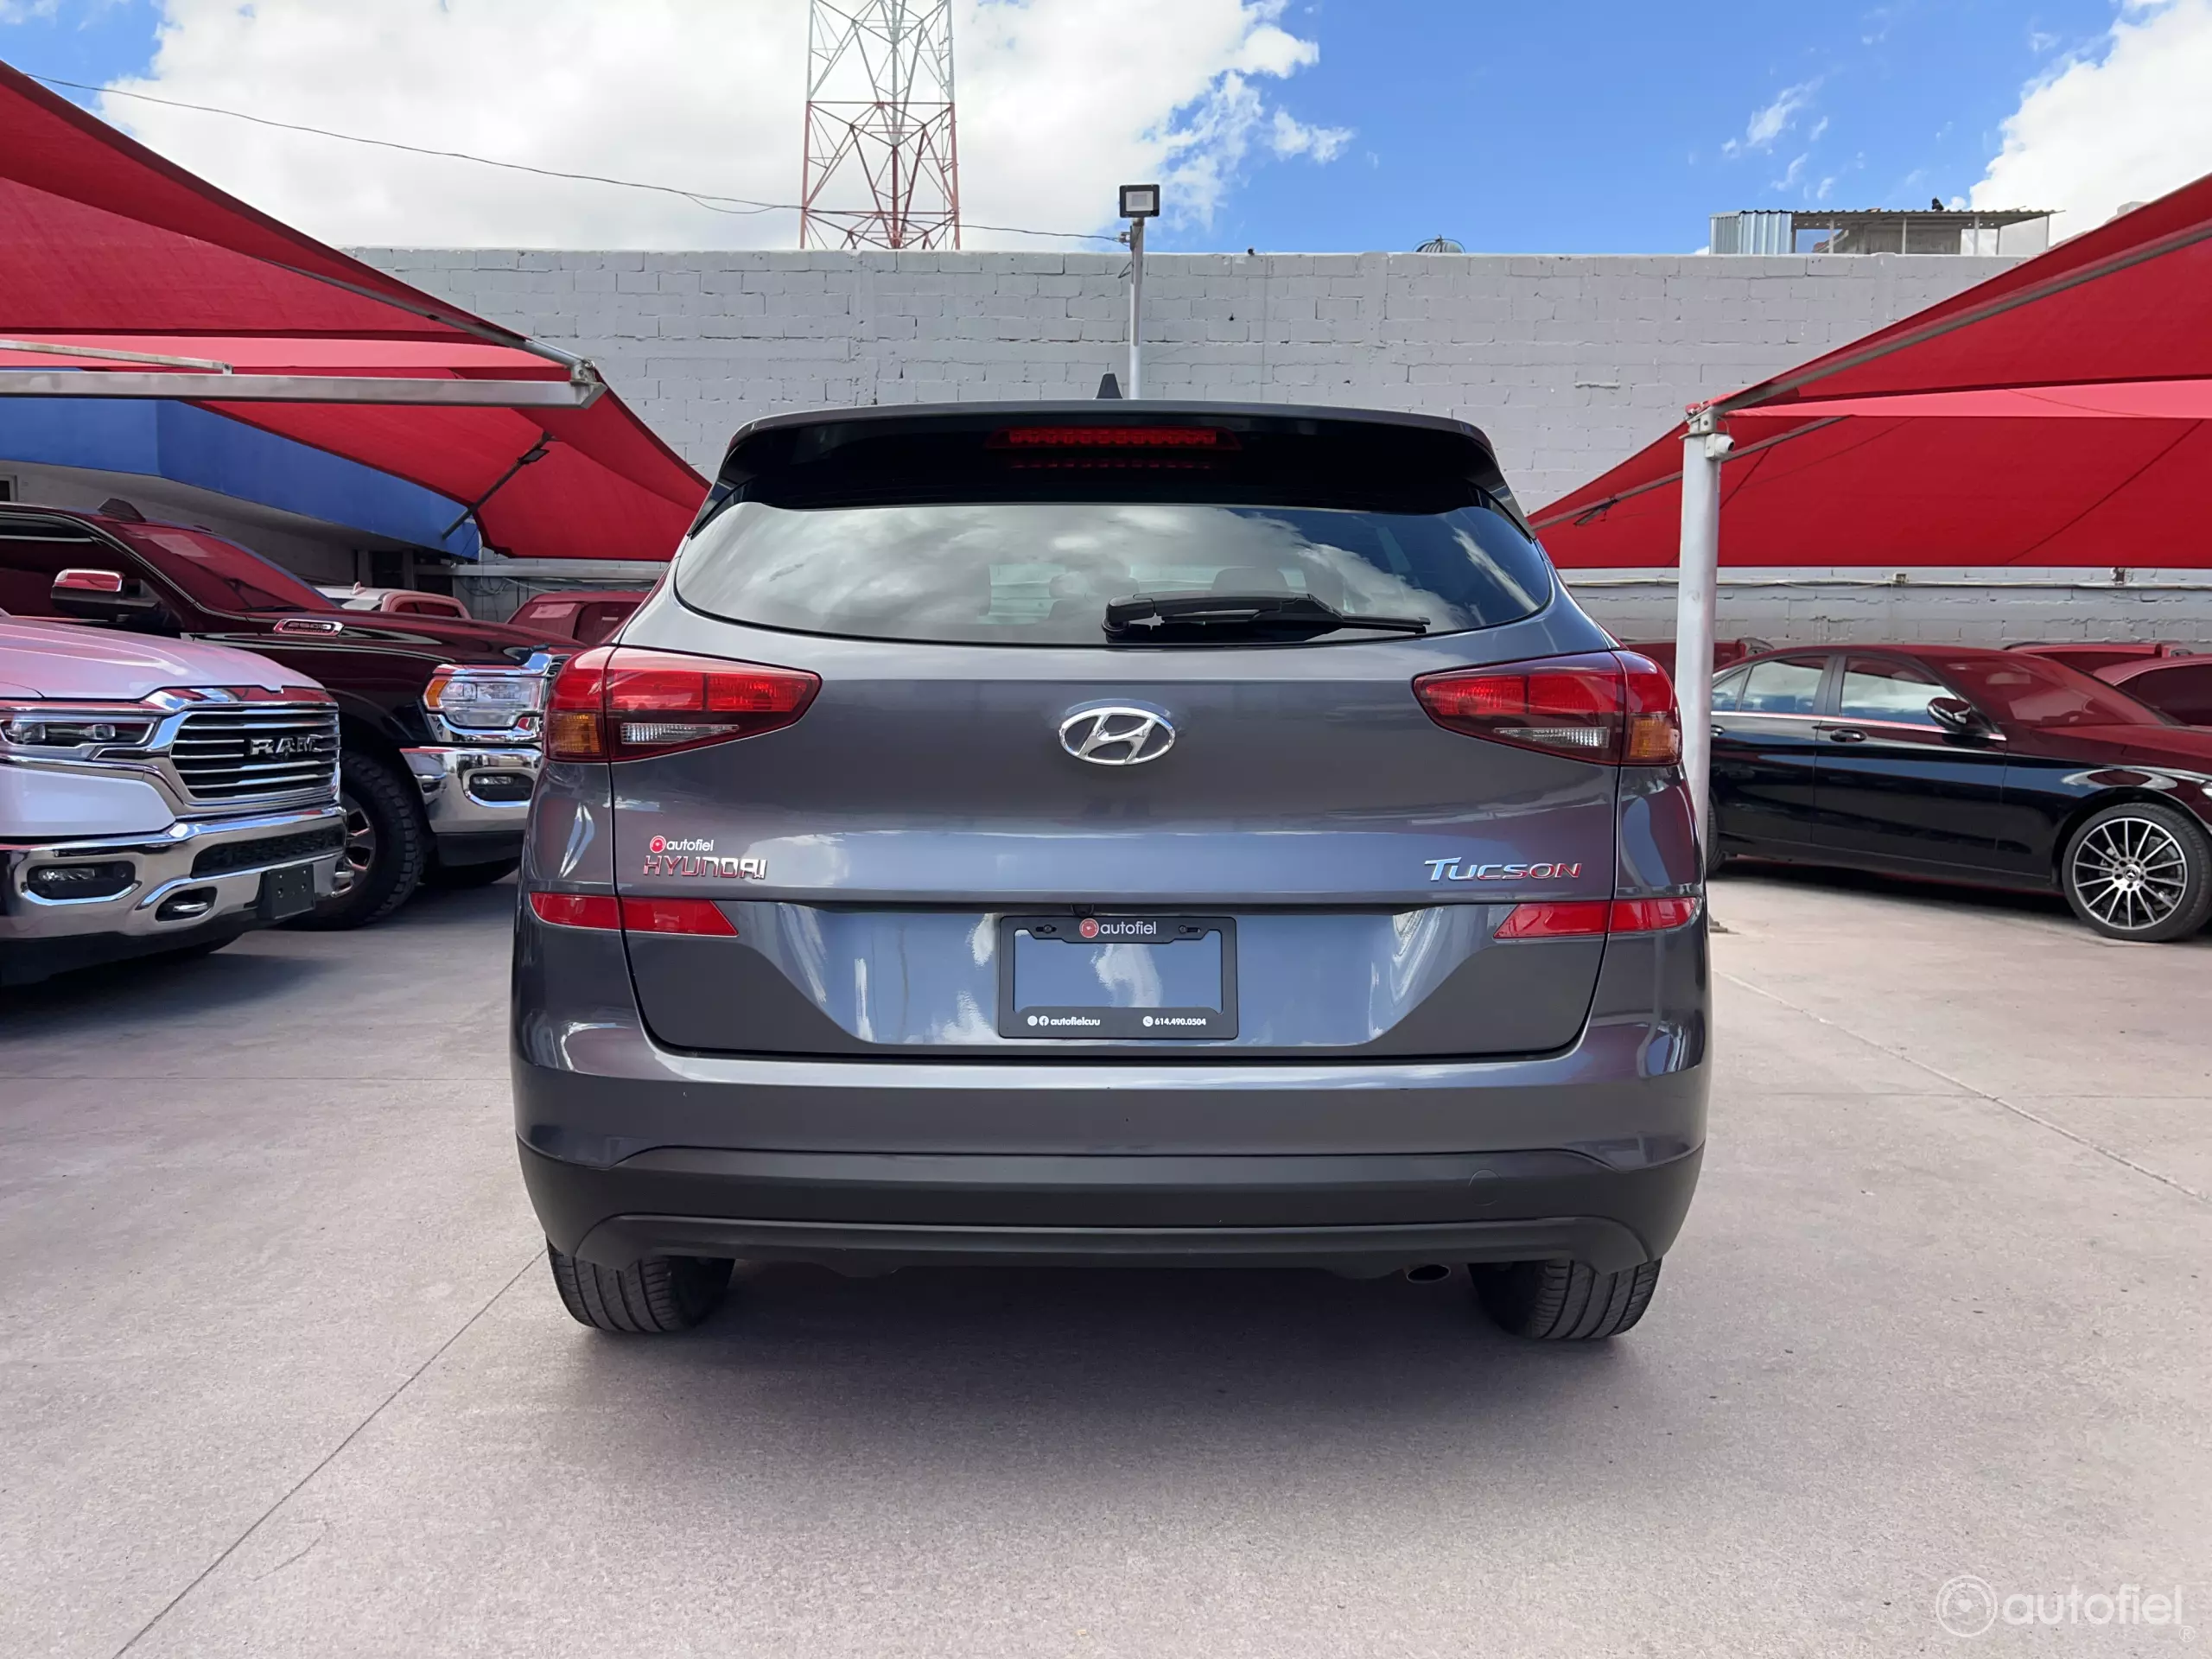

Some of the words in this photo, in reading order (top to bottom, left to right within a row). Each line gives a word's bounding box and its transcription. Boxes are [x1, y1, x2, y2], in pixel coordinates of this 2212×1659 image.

[250, 734, 323, 755] RAM
[665, 838, 715, 852] autofiel
[642, 855, 768, 880] HYUNDAI
[1423, 856, 1583, 882] TUCSON
[1100, 920, 1157, 936] autofiel
[1050, 1016, 1101, 1027] autofielcuu
[1154, 1016, 1207, 1027] 614.490.0504
